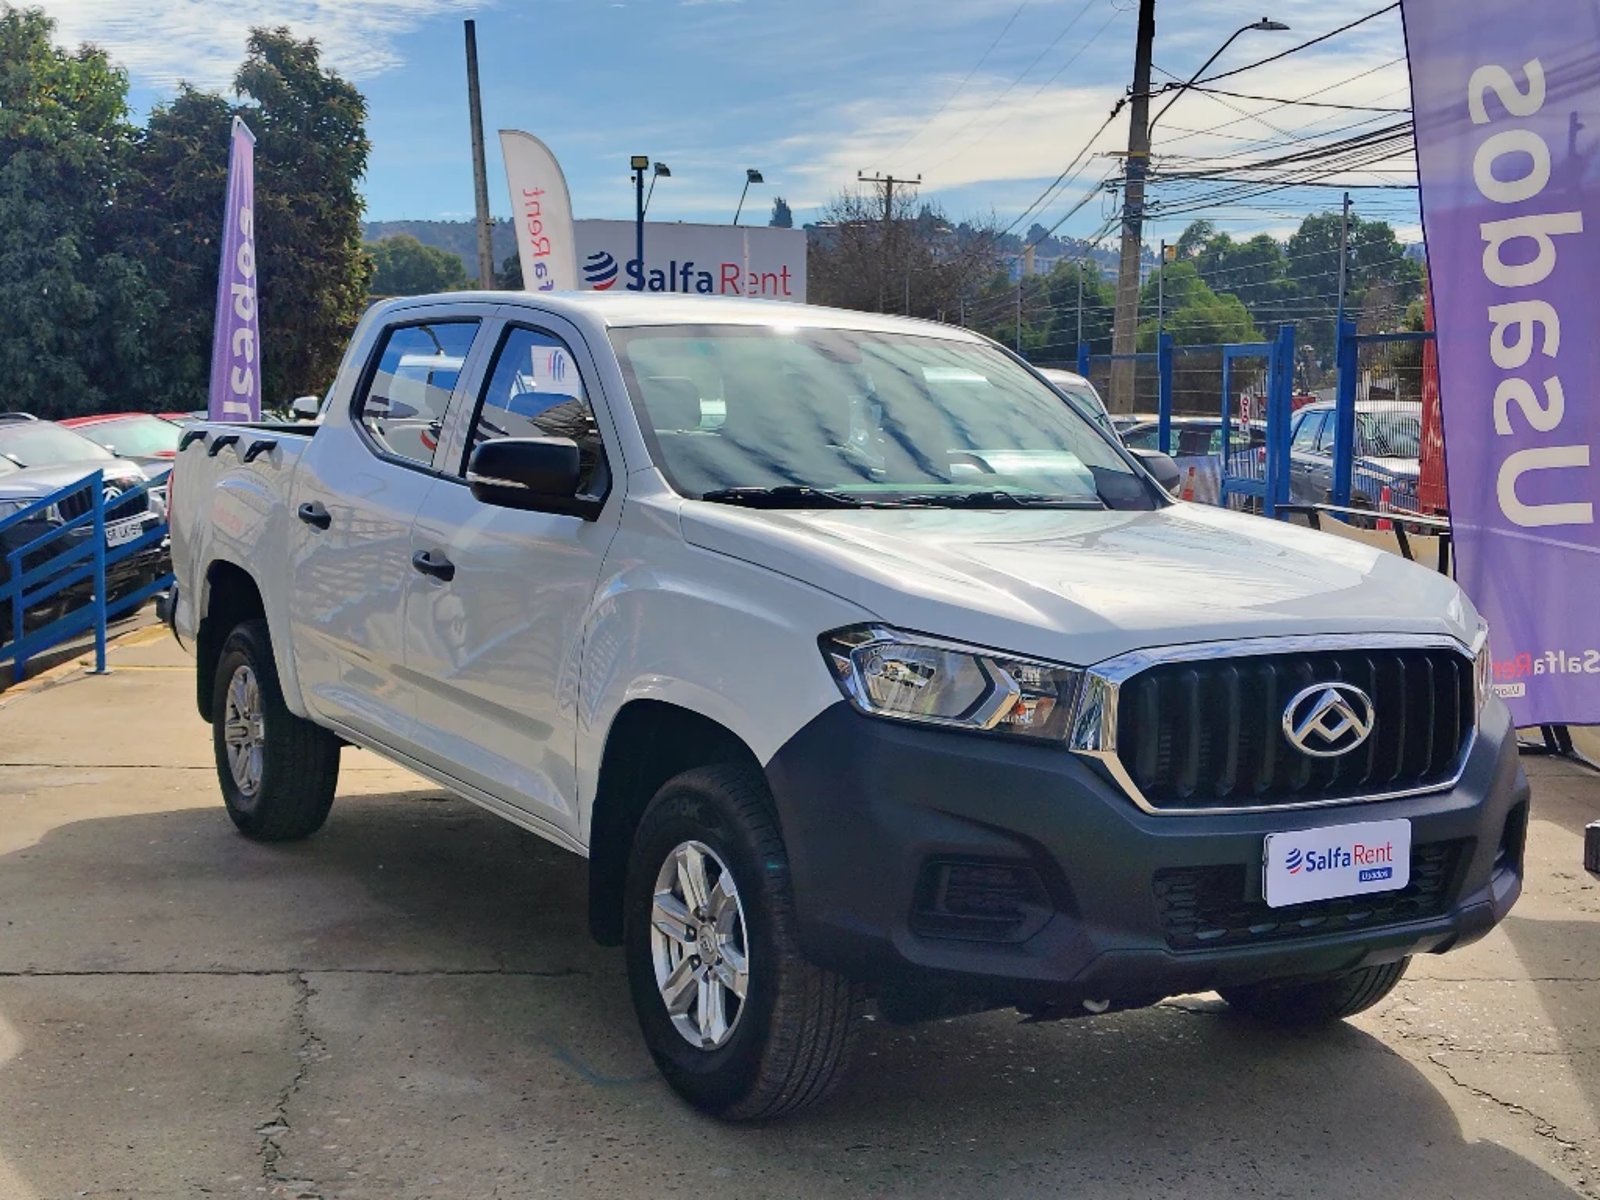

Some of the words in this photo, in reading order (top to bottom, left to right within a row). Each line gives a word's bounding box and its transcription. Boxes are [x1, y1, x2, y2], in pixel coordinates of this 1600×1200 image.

[625, 258, 792, 296] SalfaRent
[1305, 841, 1393, 872] SalfaRent
[1361, 869, 1389, 881] Usados
